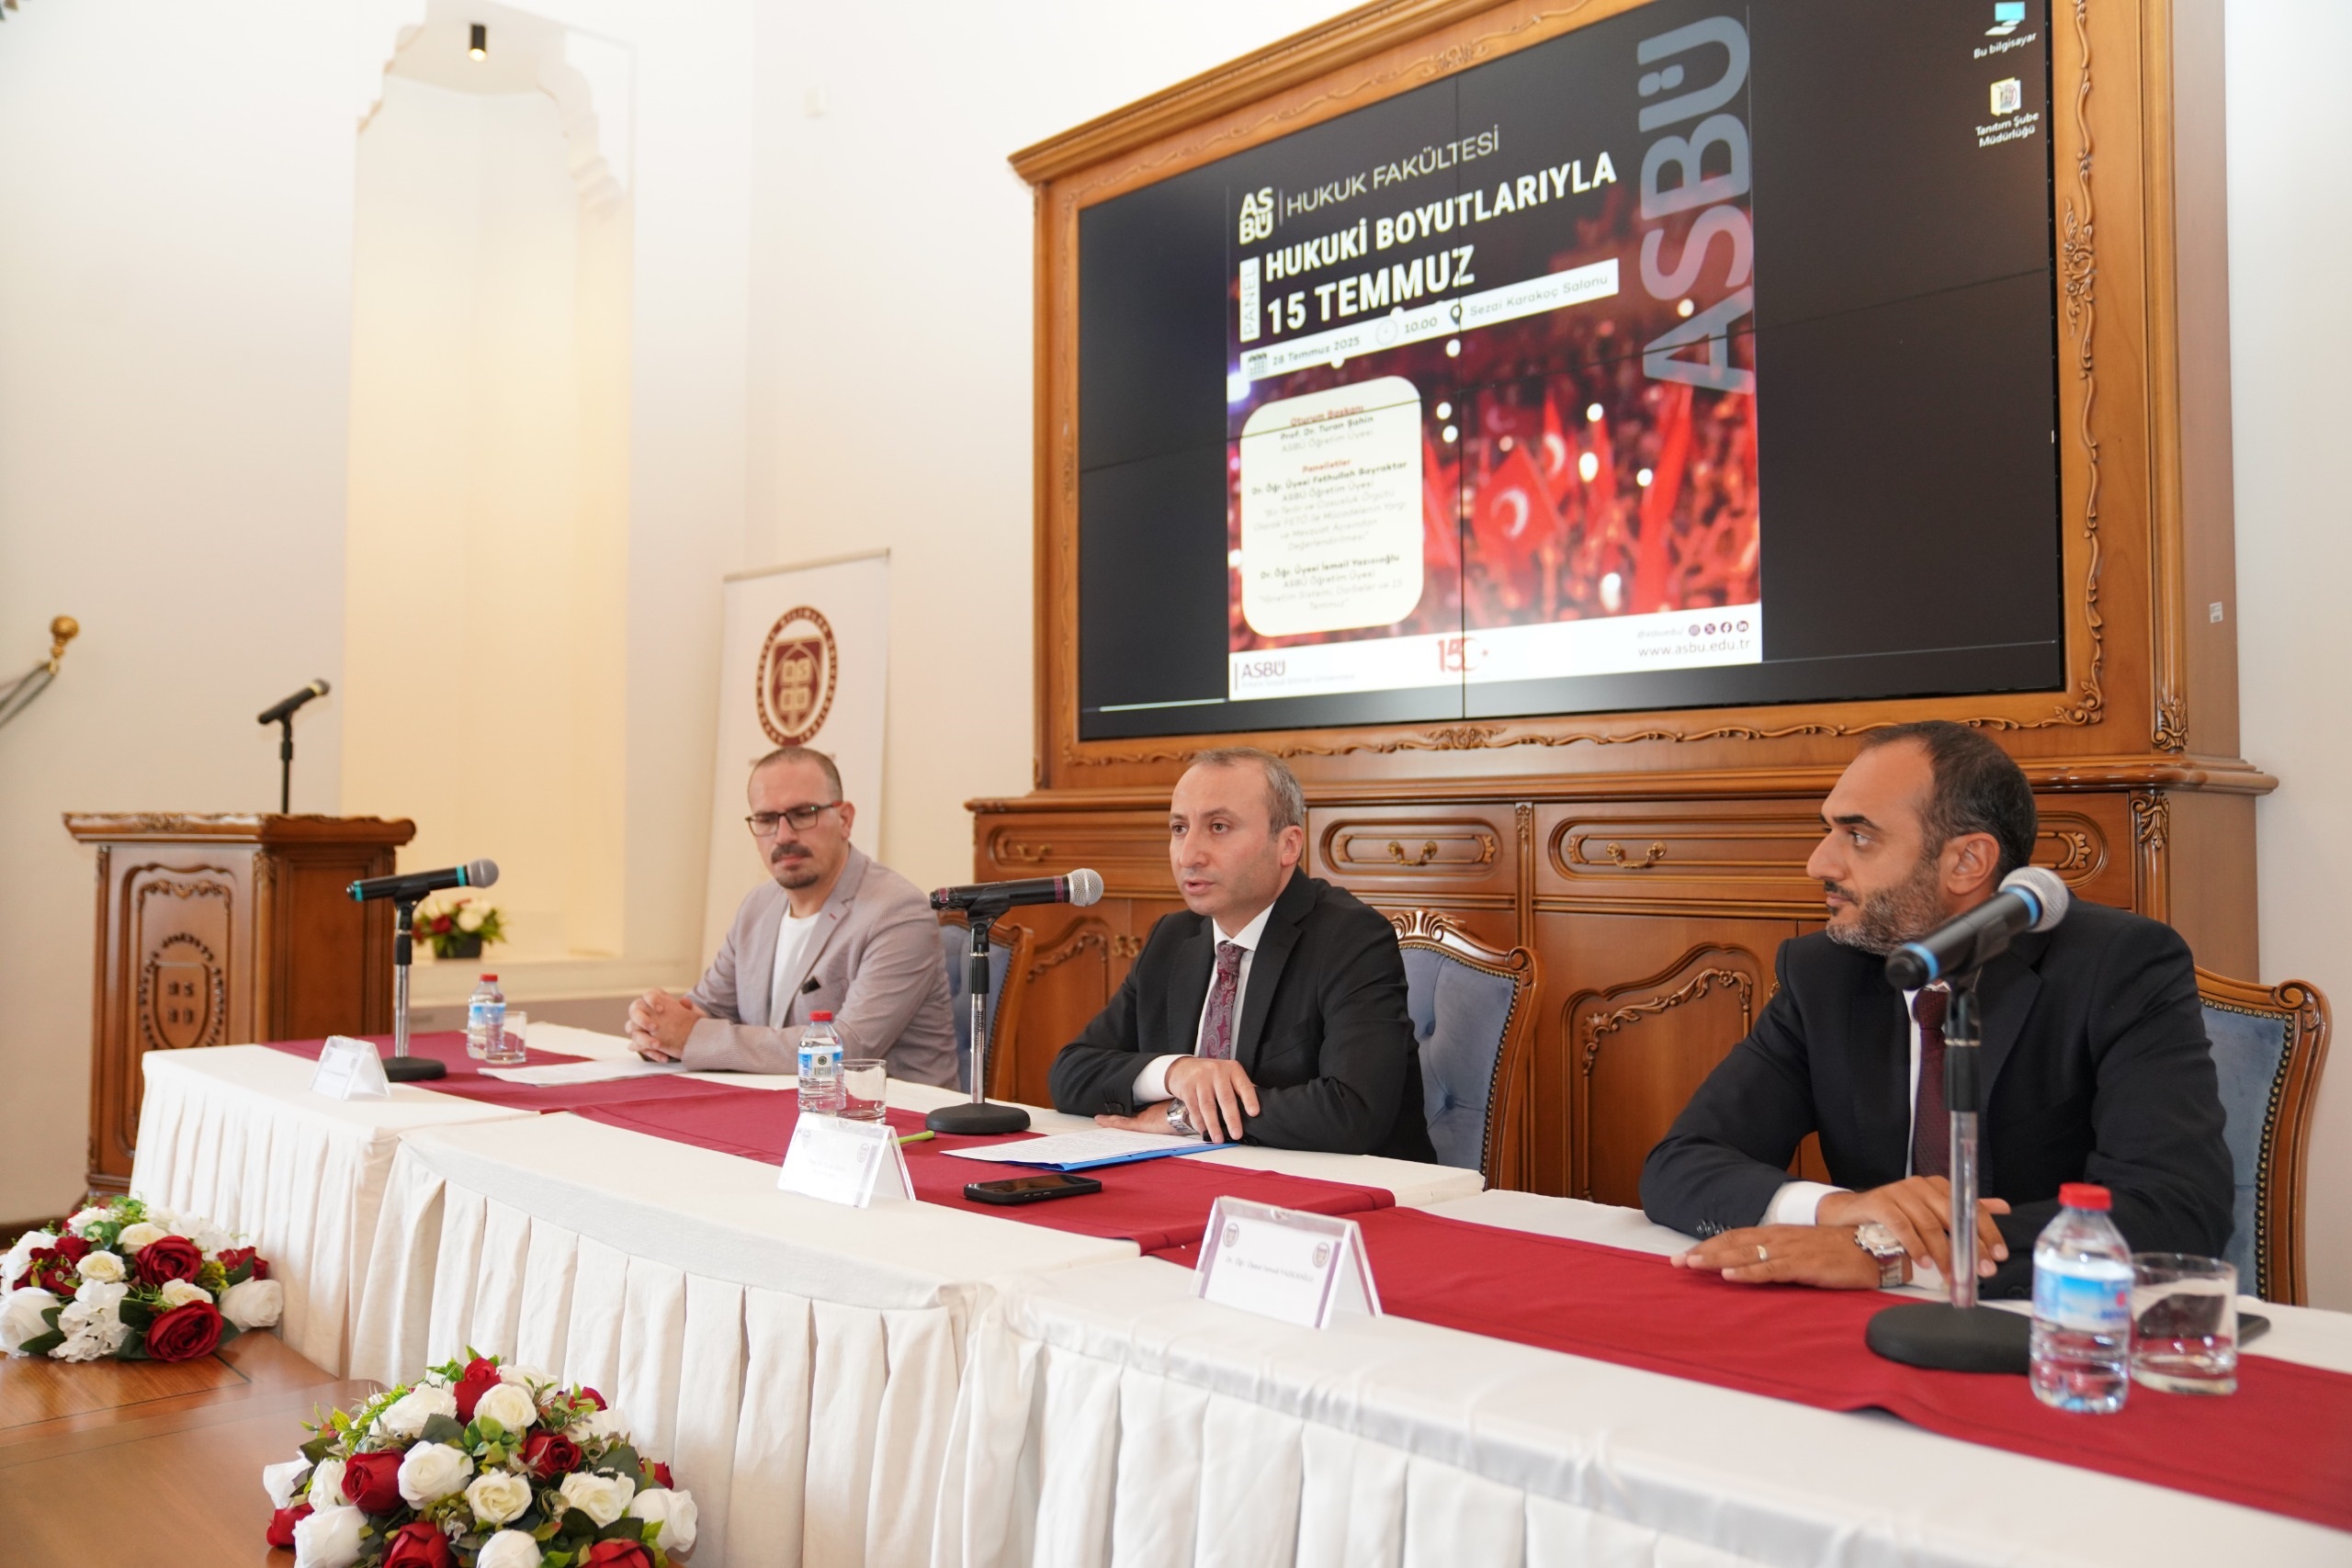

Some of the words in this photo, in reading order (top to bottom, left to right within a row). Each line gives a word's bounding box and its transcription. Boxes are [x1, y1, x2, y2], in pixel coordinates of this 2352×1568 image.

[1973, 48, 1987, 59] Bu
[1989, 32, 2037, 54] bilgisayar
[2013, 112, 2040, 128] Şube
[1979, 125, 2036, 148] Müdürlüğü
[1286, 172, 1368, 218] HUKUK
[1373, 124, 1499, 189] FAKÜLTESİ
[1240, 186, 1274, 219] AS
[1636, 15, 1754, 395] ASBÜ
[1239, 211, 1274, 245] BÜ
[1265, 217, 1368, 283] HUKUKİ
[1375, 151, 1617, 251] BOYUTLARIYLA
[1243, 267, 1258, 336] PANEL
[1267, 290, 1306, 334] 15
[1314, 243, 1476, 322] TEMMUZ
[1469, 299, 1503, 316] Sezai
[1506, 287, 1559, 308] Karakoç
[1563, 276, 1608, 294] Salonu
[1404, 317, 1439, 333] 10.00
[1287, 345, 1330, 362] Temmuz
[1333, 336, 1361, 351] 2025
[1290, 412, 1325, 427] Oturum
[1318, 423, 1344, 434] Turan
[1284, 477, 1310, 489] Üyesi
[1312, 470, 1356, 484] Fethullah
[1358, 461, 1408, 477] Bayraktar
[1294, 563, 1319, 574] Üyesi
[1637, 638, 1751, 658] www.asbu.edu.tr
[1242, 660, 1286, 679] ASBÜ
